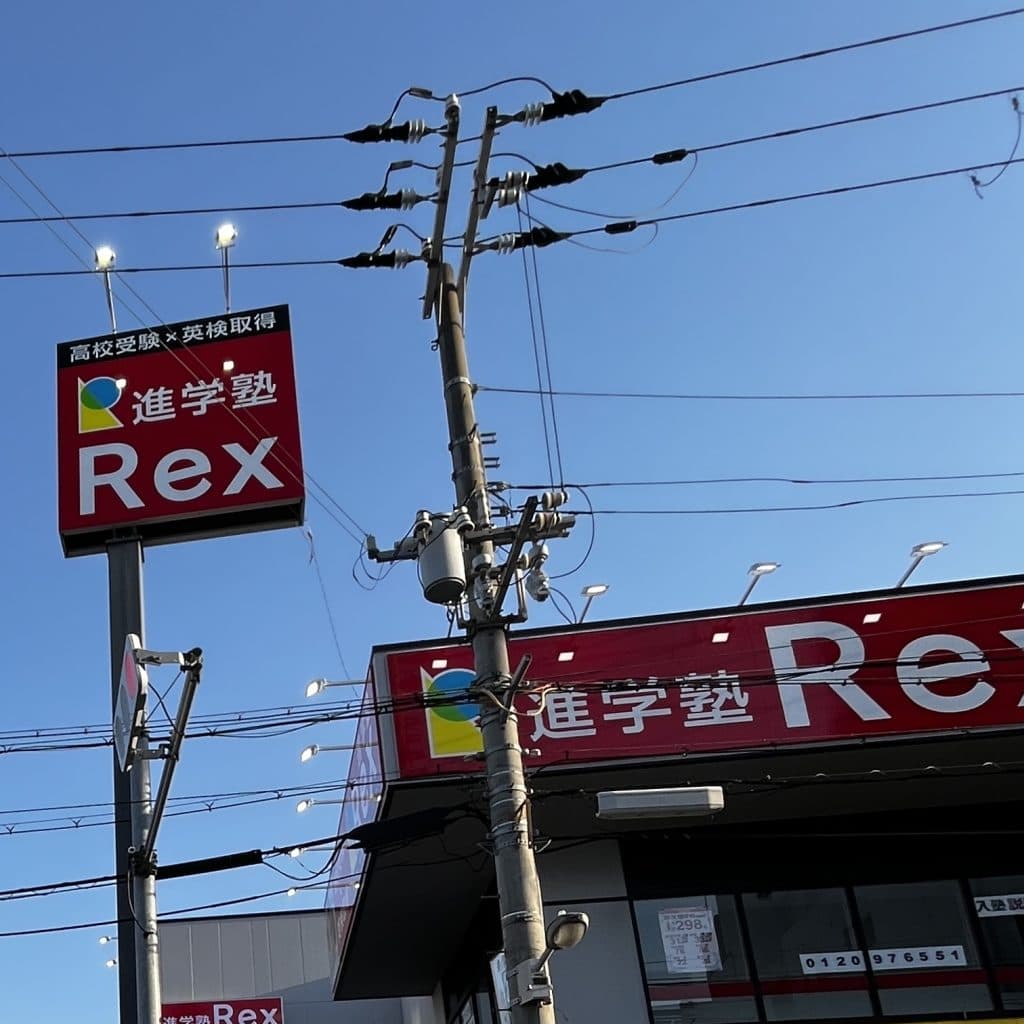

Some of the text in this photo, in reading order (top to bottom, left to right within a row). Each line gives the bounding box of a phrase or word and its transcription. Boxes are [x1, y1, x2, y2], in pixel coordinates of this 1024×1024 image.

[70, 311, 276, 363] 高校受験×英検取得
[132, 370, 277, 425] 進学塾
[79, 436, 285, 516] Rex
[527, 621, 1024, 741] 進学塾 Re
